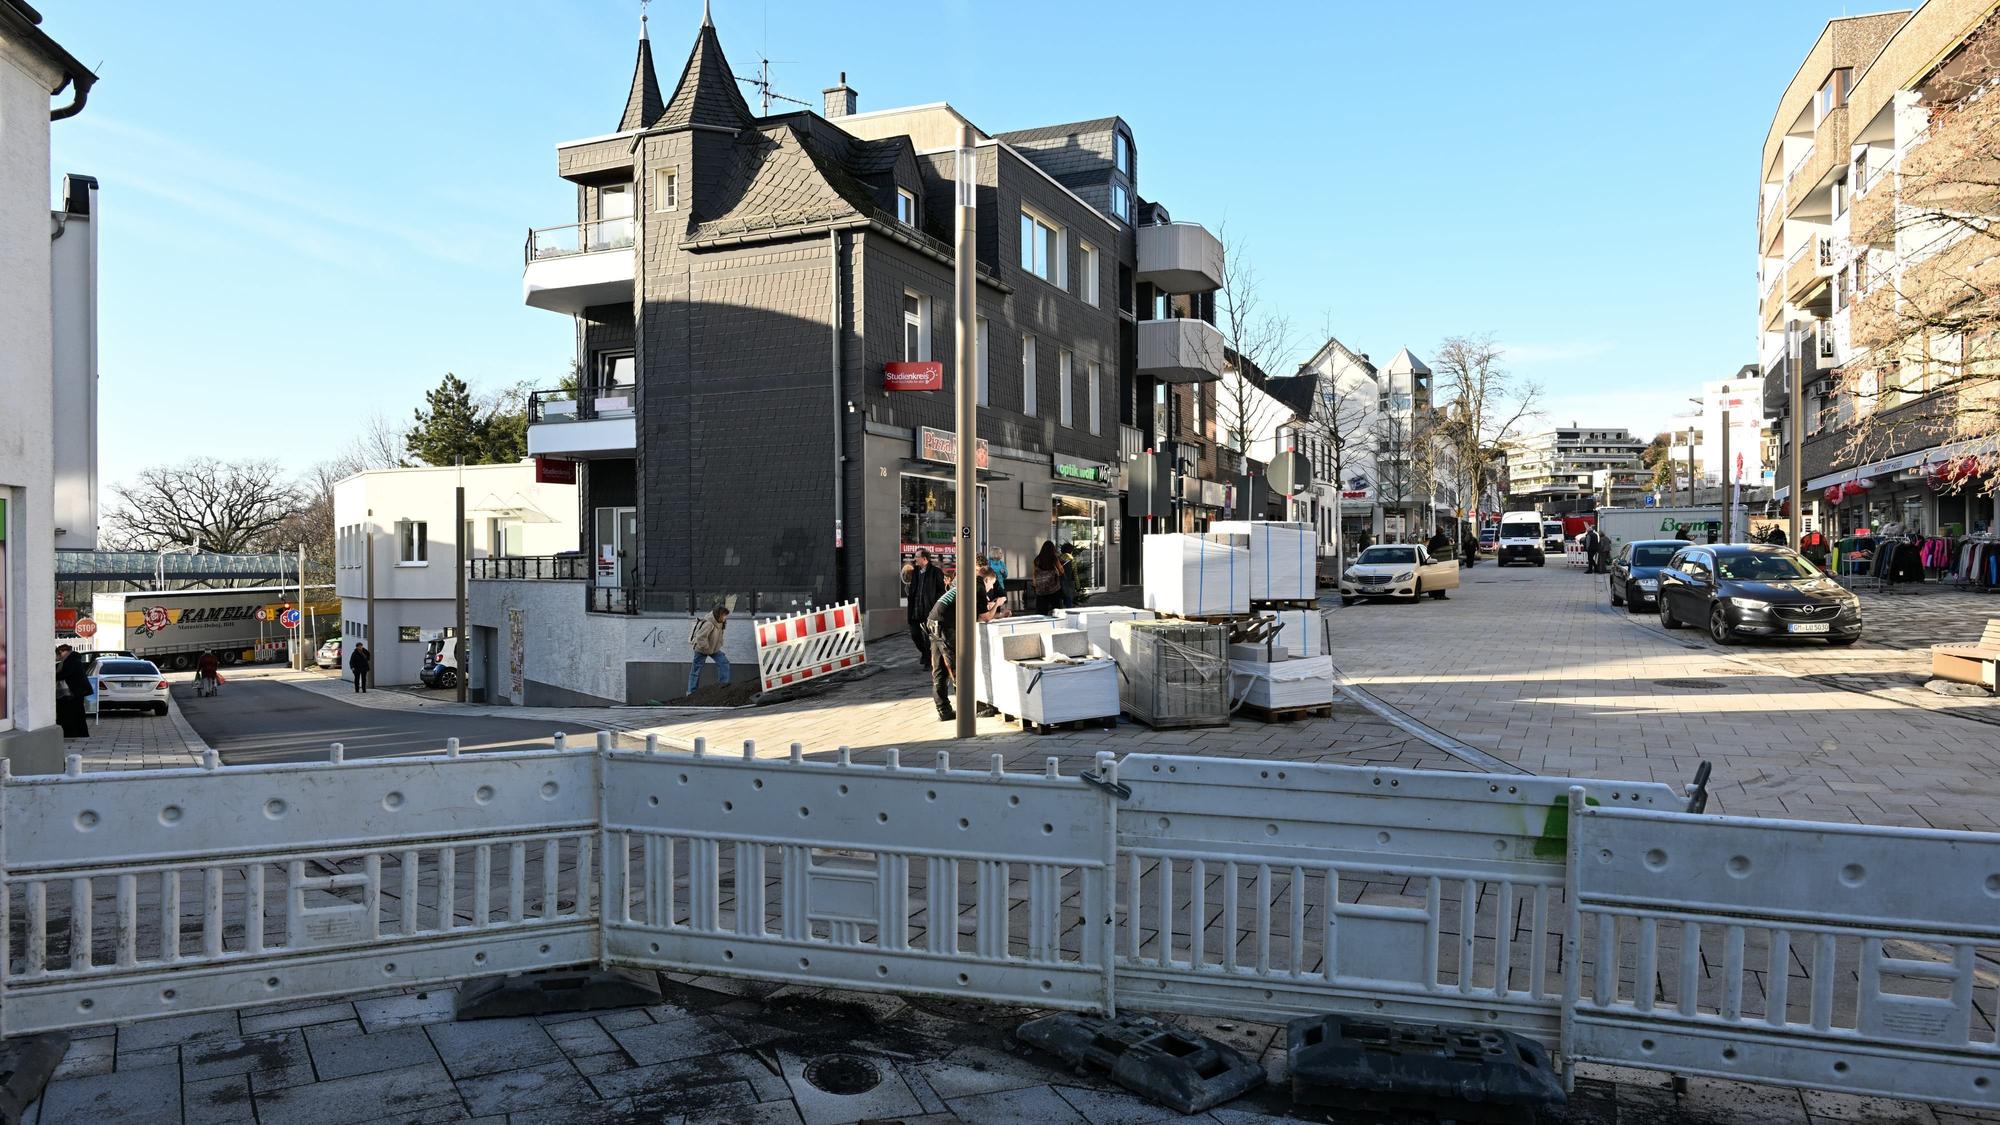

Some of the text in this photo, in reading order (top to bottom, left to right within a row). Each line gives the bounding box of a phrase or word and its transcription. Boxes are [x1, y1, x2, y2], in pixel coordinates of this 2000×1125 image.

[886, 372, 929, 380] Studienkreis
[924, 431, 952, 453] Pizza
[1060, 464, 1079, 477] optik
[77, 624, 95, 632] STOP
